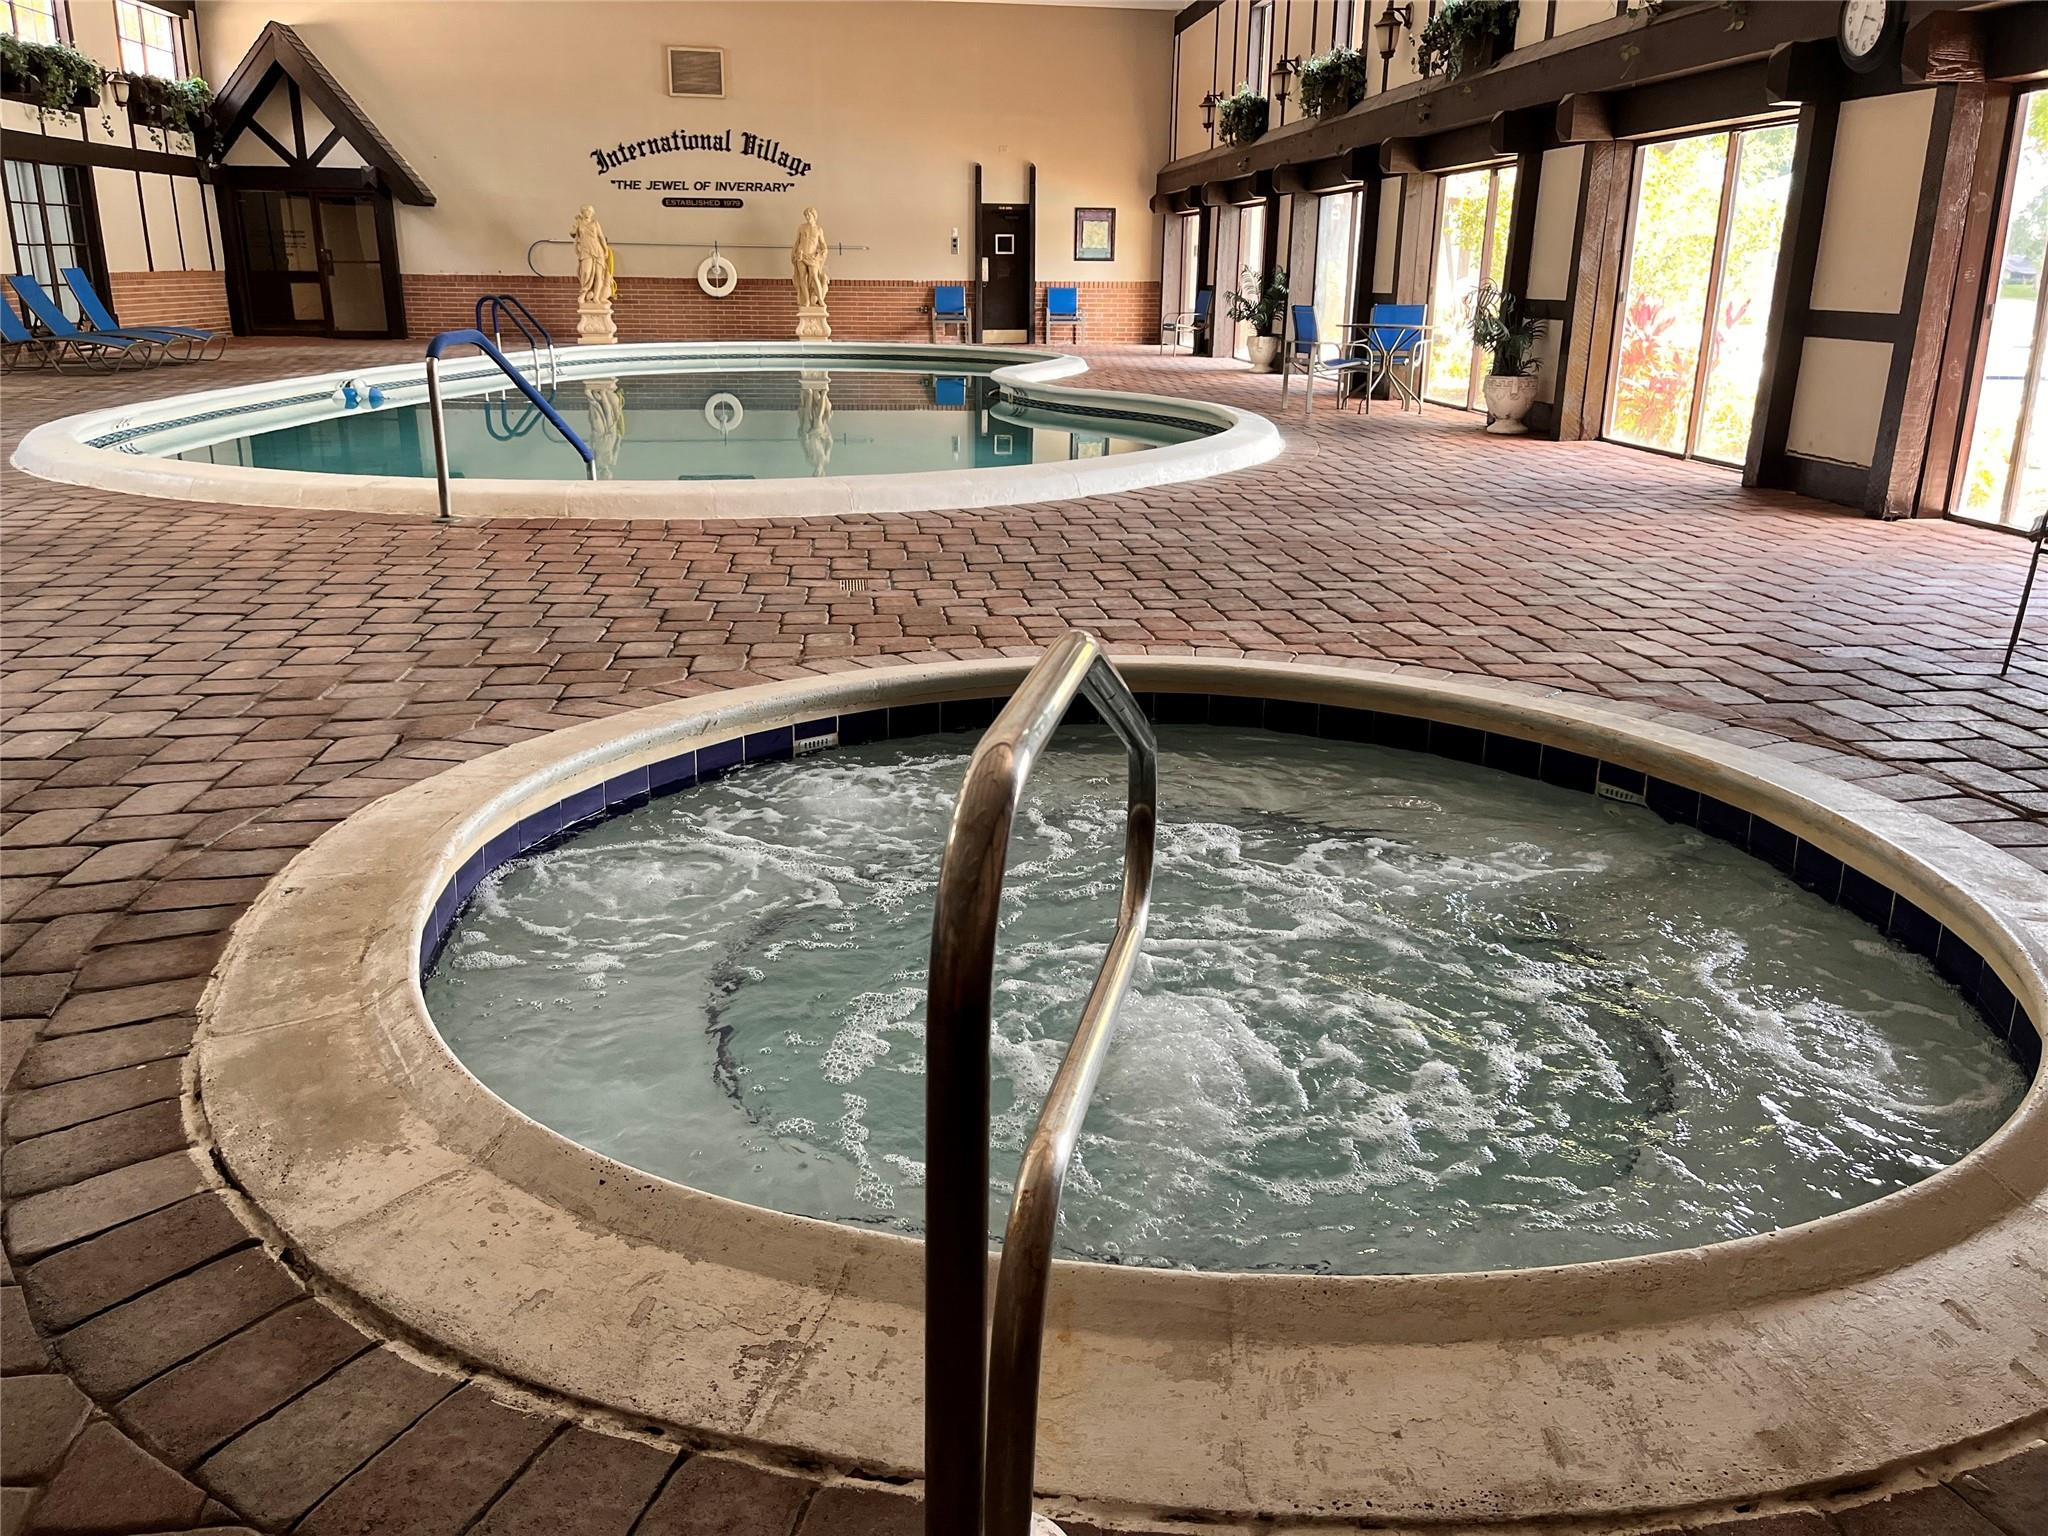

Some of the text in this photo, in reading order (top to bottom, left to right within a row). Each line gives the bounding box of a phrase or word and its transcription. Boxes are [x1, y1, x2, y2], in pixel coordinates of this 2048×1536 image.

[1848, 16, 1853, 26] 9
[590, 129, 812, 177] International Village
[646, 180, 690, 191] JEWEL
[693, 181, 711, 191] OF
[715, 181, 795, 192] INVERRARY"
[665, 199, 721, 207] ESTABLISHED
